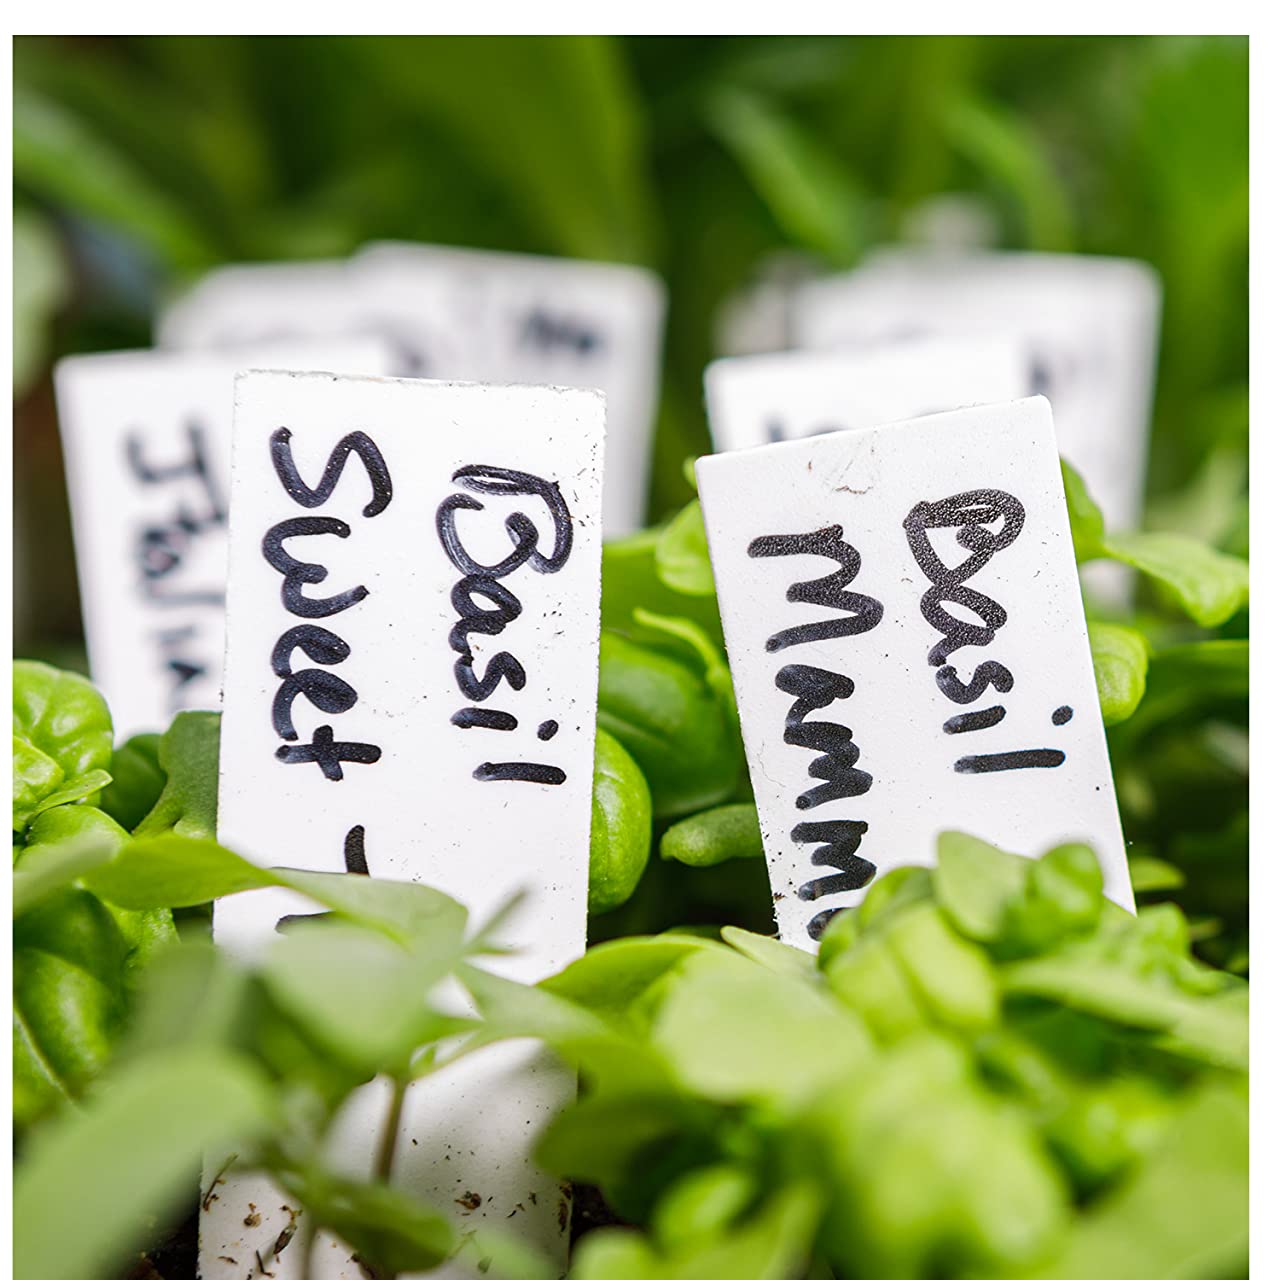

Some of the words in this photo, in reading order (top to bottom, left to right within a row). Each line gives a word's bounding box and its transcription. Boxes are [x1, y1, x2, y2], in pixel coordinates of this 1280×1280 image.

[262, 425, 394, 782] Sweet
[435, 463, 574, 786] Basil
[902, 488, 1075, 775] Basil
